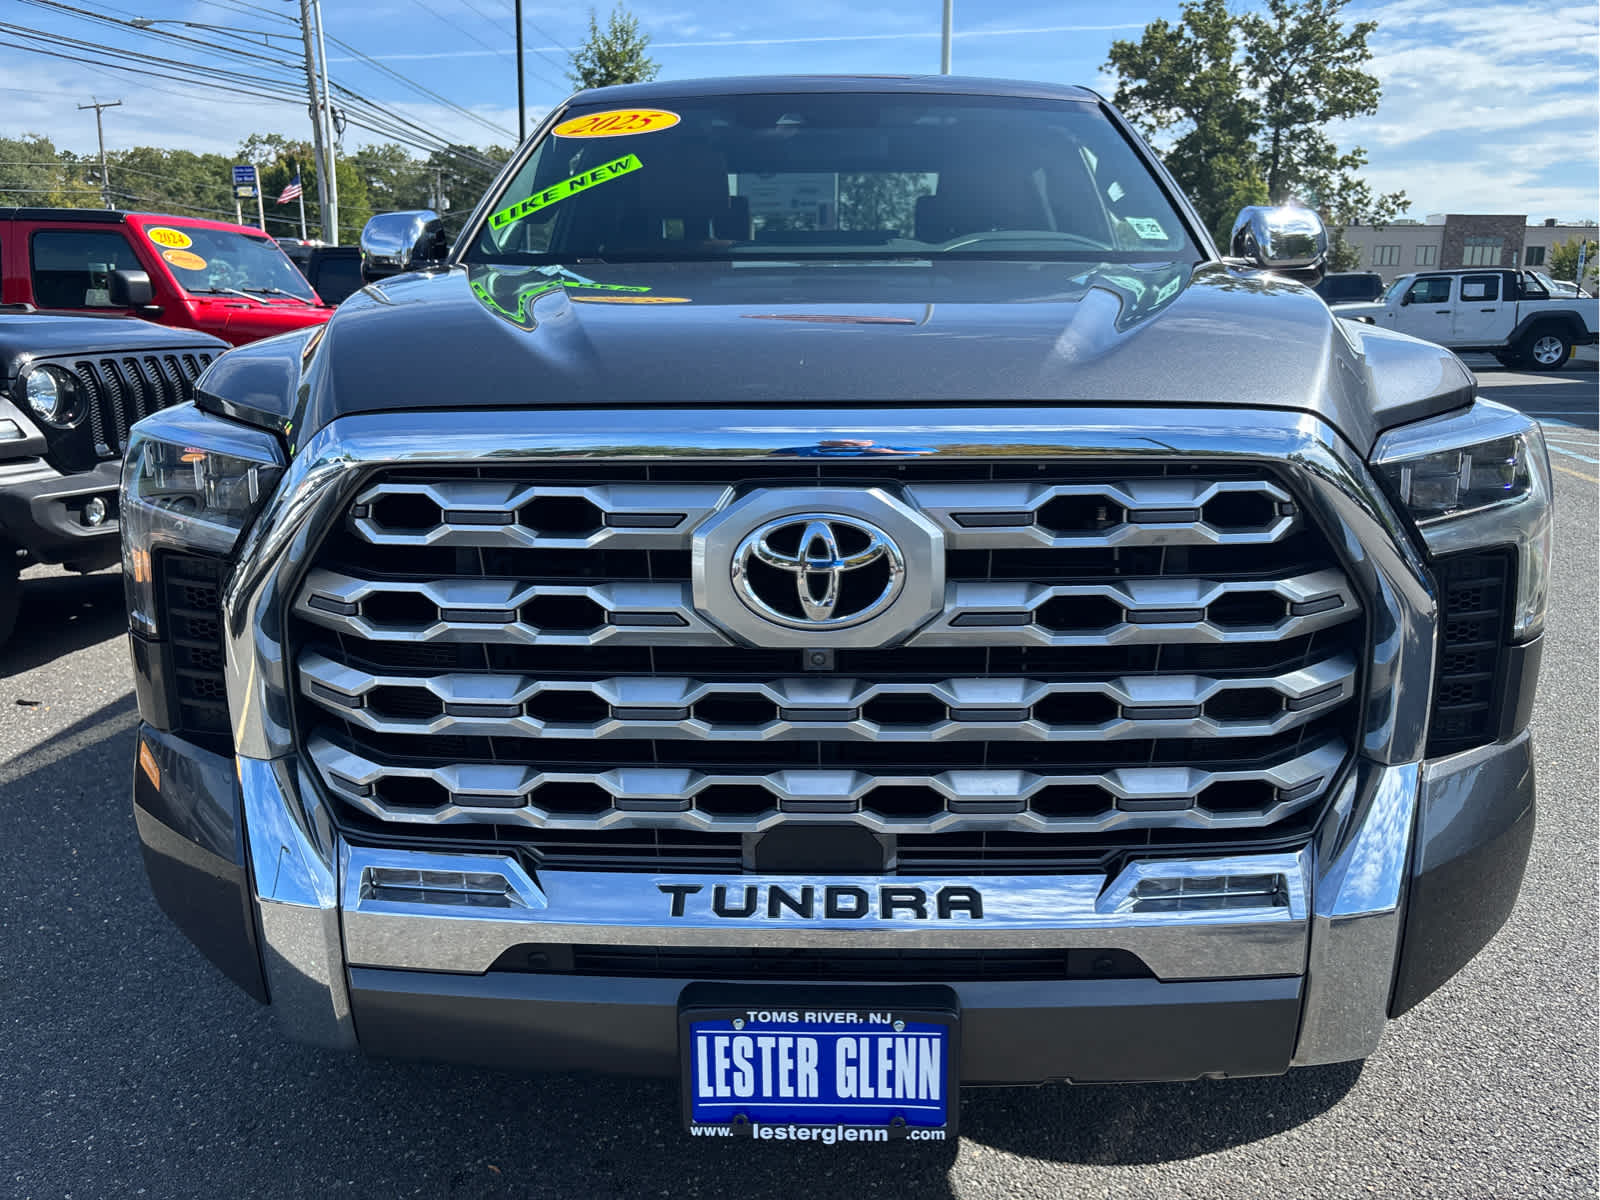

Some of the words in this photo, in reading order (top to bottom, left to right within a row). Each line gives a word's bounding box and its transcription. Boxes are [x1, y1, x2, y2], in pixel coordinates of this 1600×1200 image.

[567, 113, 663, 135] 2025
[493, 187, 561, 227] LIKE
[568, 158, 632, 193] NEW
[155, 231, 185, 244] 2024
[655, 884, 984, 920] TUNDRA
[747, 1011, 799, 1024] TOMS
[804, 1012, 864, 1025] RIVER,
[869, 1012, 892, 1025] NJ
[697, 1035, 819, 1098] LESTER
[835, 1037, 941, 1100] GLENN
[690, 1125, 734, 1137] www.
[752, 1123, 889, 1145] lesterglenn
[905, 1129, 945, 1141] .com
